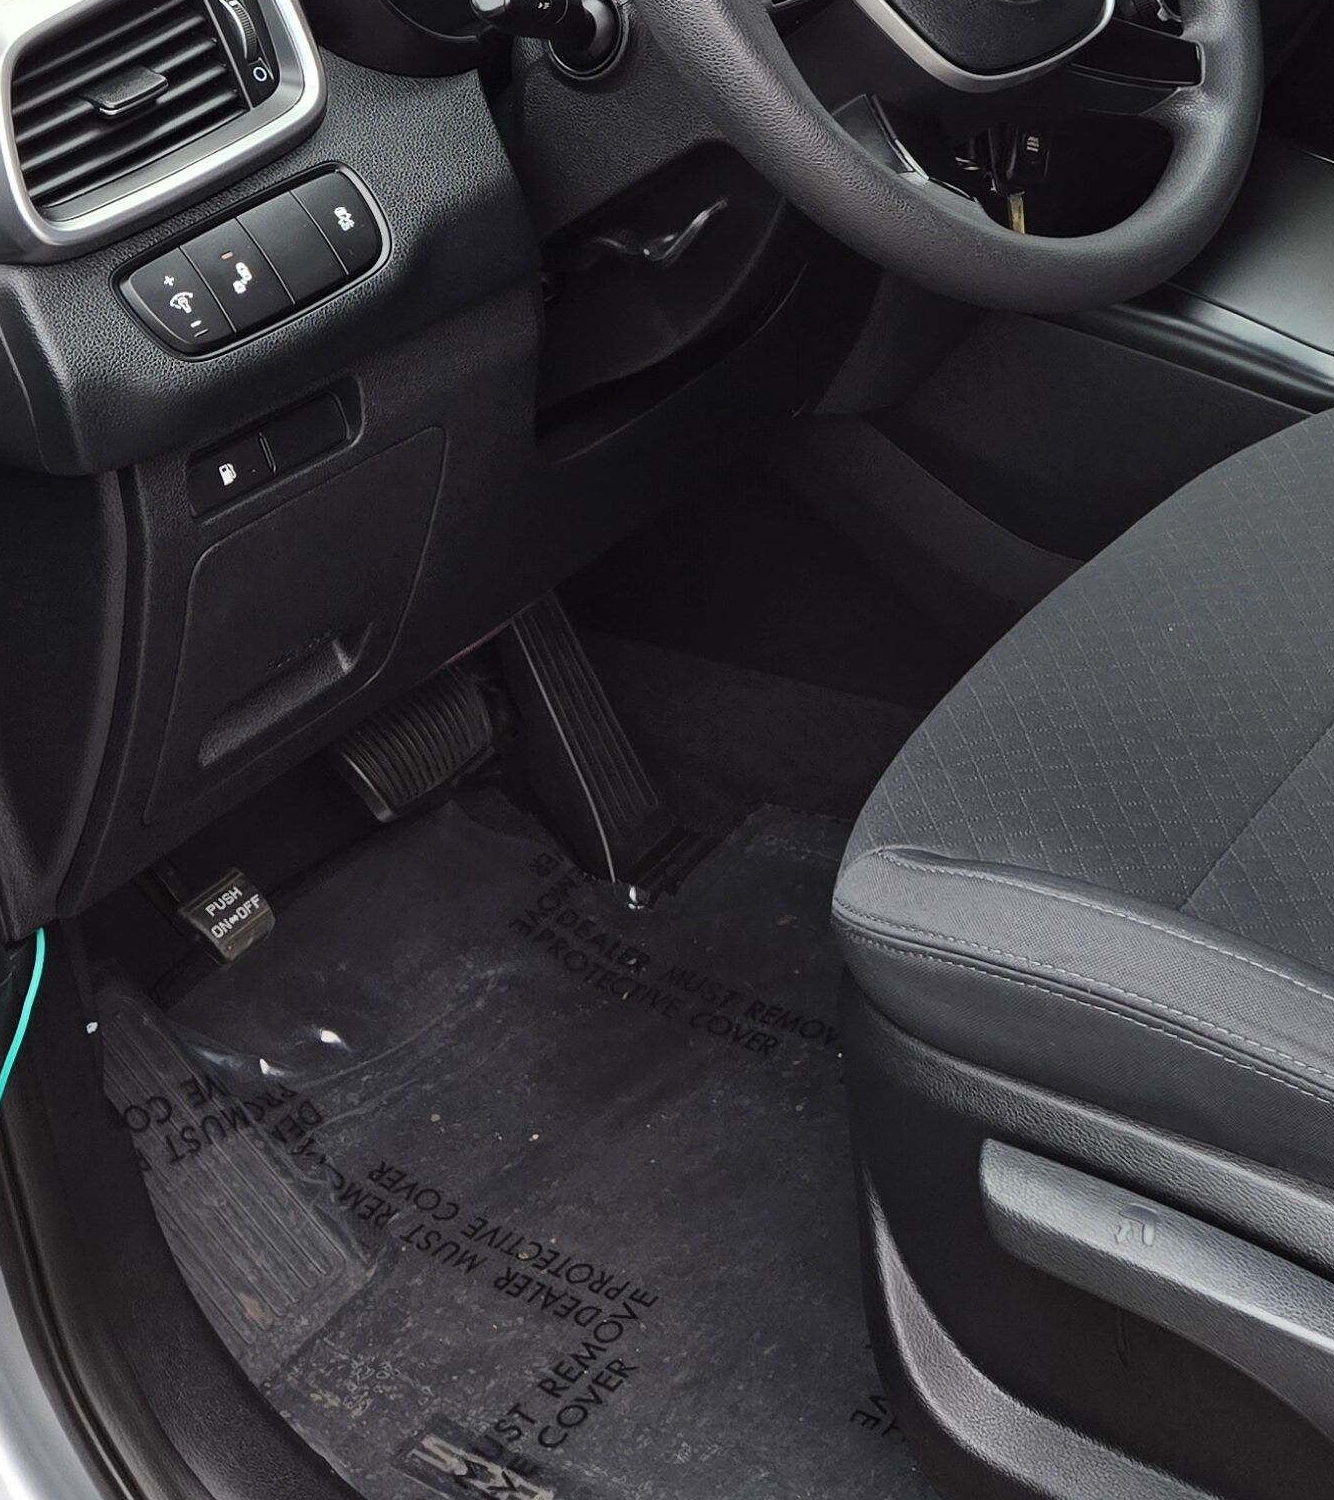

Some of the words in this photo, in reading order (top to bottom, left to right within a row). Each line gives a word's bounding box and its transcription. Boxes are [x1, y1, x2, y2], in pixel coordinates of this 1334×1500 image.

[205, 886, 243, 917] PUSH
[236, 894, 261, 920] OFF
[533, 929, 681, 1019] PROTECTIVE
[689, 1010, 780, 1057] COVER
[556, 908, 650, 975] DEALER
[660, 964, 743, 1010] MUST
[744, 999, 841, 1048] REMOV
[368, 1160, 461, 1222] COVER
[400, 1223, 488, 1275] MUST
[460, 1217, 631, 1303] PROTECTIVE
[494, 1267, 603, 1329] DEALER
[537, 1287, 660, 1399] REMOVE
[537, 1357, 640, 1449] COVER
